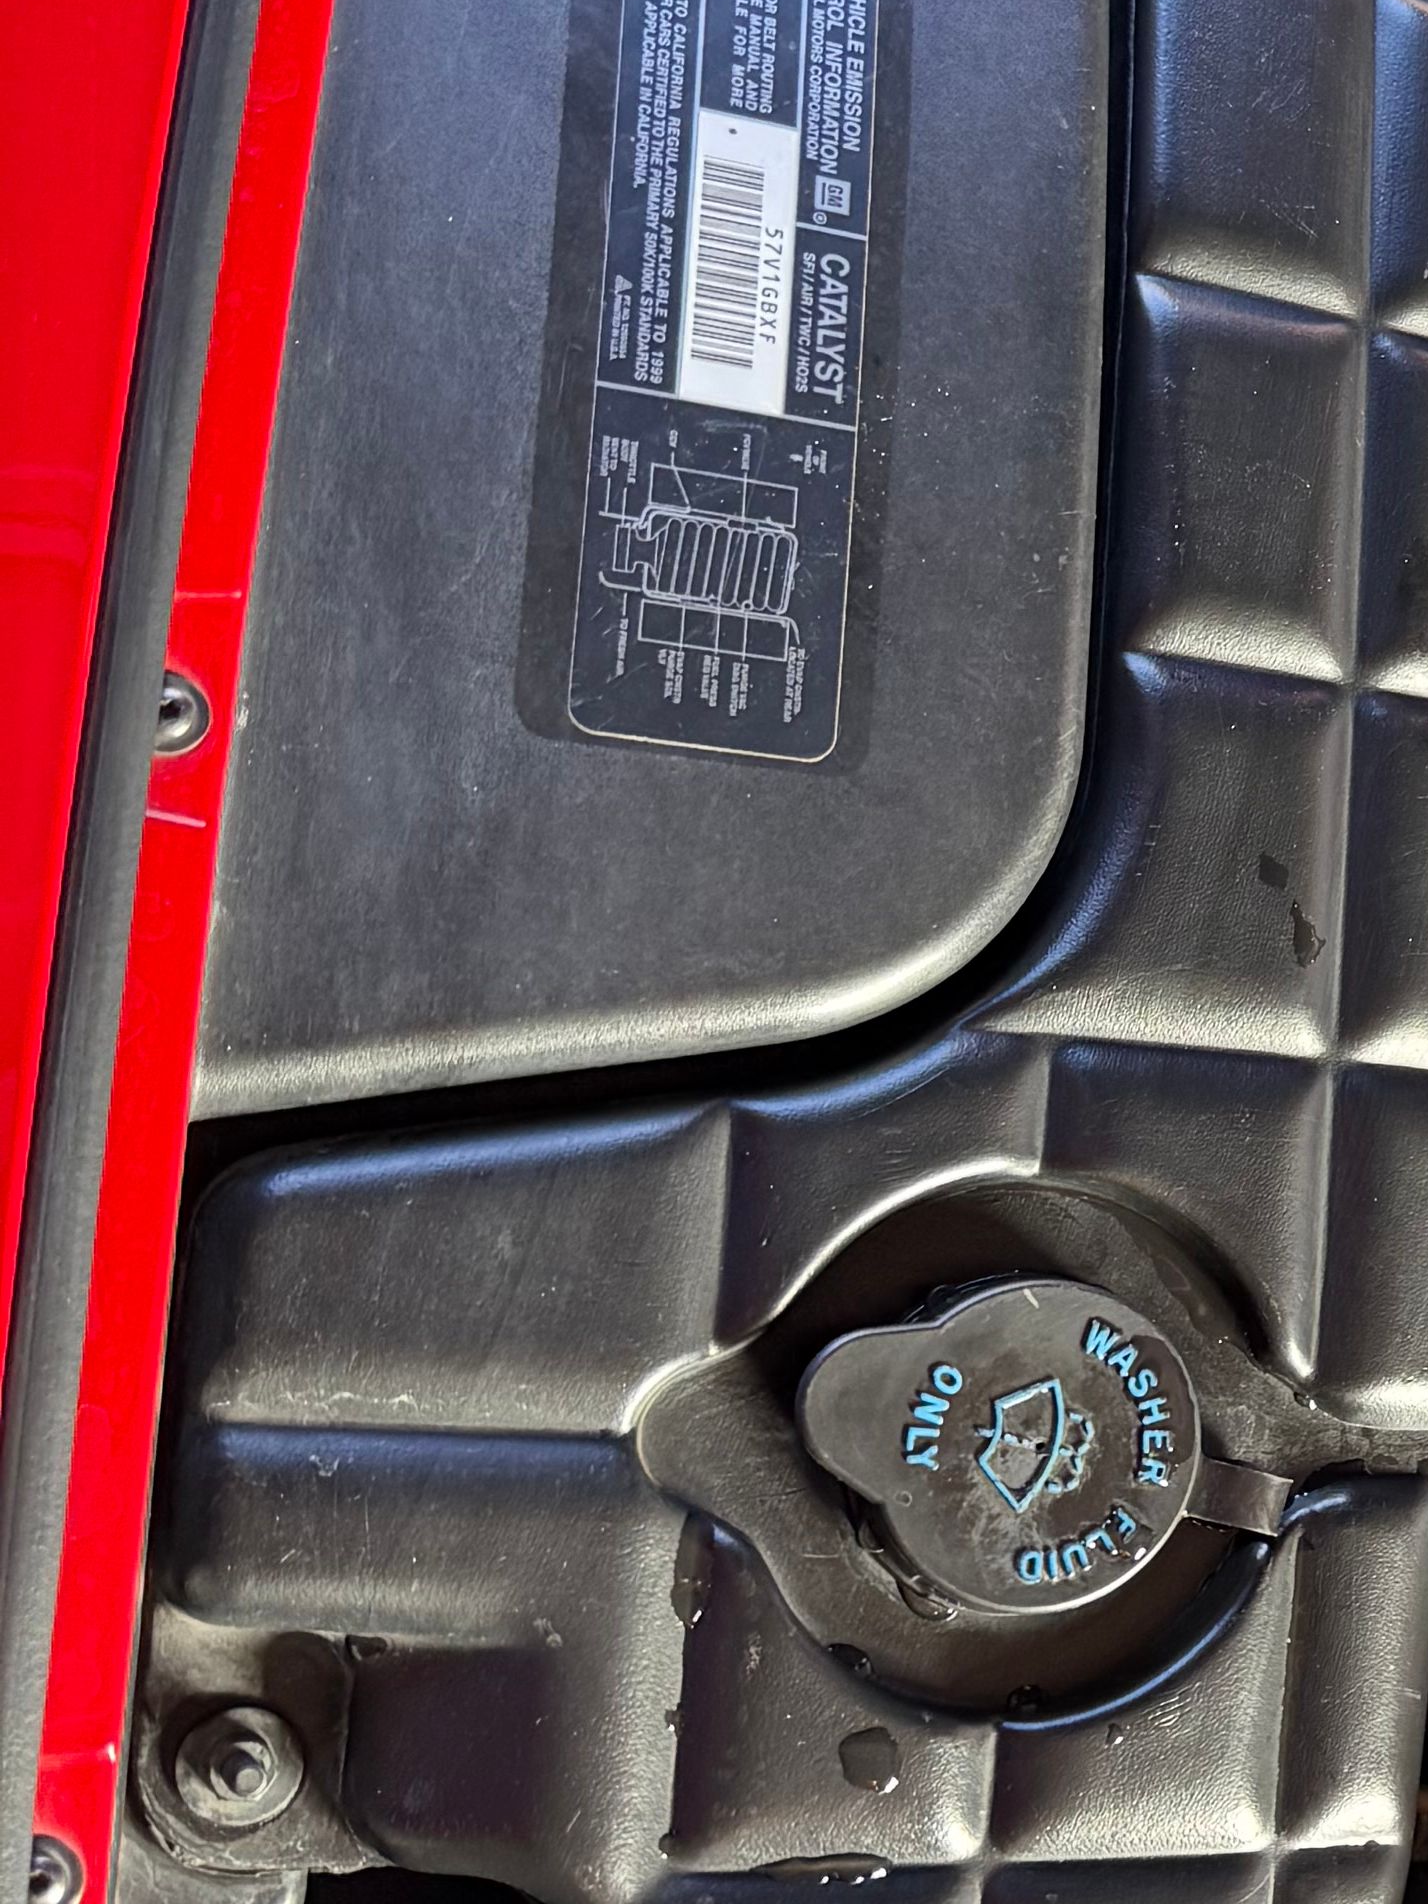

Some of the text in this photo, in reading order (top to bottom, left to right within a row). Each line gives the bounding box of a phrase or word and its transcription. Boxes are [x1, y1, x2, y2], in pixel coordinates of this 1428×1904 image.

[639, 0, 659, 87] APPLICABLE
[658, 8, 673, 47] CARS
[733, 24, 748, 57] FOR
[747, 13, 763, 74] MANUAL
[762, 16, 777, 52] BELT
[810, 7, 826, 63] MOTORS
[639, 85, 653, 103] IN
[653, 47, 670, 118] CERTIFIED
[668, 21, 687, 111] CALIFORNIA
[730, 62, 746, 109] MORE
[745, 79, 760, 112] AND
[760, 52, 775, 114] ROUTING
[651, 117, 666, 139] TO
[806, 63, 823, 160] CORPORATION
[819, 39, 844, 175] INFORMATION
[842, 56, 865, 152] EMISSION
[633, 103, 652, 190] CALIFORNIA.
[650, 136, 665, 167] THE
[661, 115, 681, 219] REGULATIONS
[645, 166, 663, 231] PRIMARY
[640, 230, 658, 295] 50K/100K
[654, 223, 674, 318] APPLICABLE
[758, 226, 784, 345] 57V1GBXF
[634, 293, 654, 383] STANDARDS
[653, 321, 667, 344] TO
[812, 250, 852, 405] CATALYST
[649, 349, 665, 385] 1999
[903, 1318, 1174, 1586] WASHER FLUID ONLY
